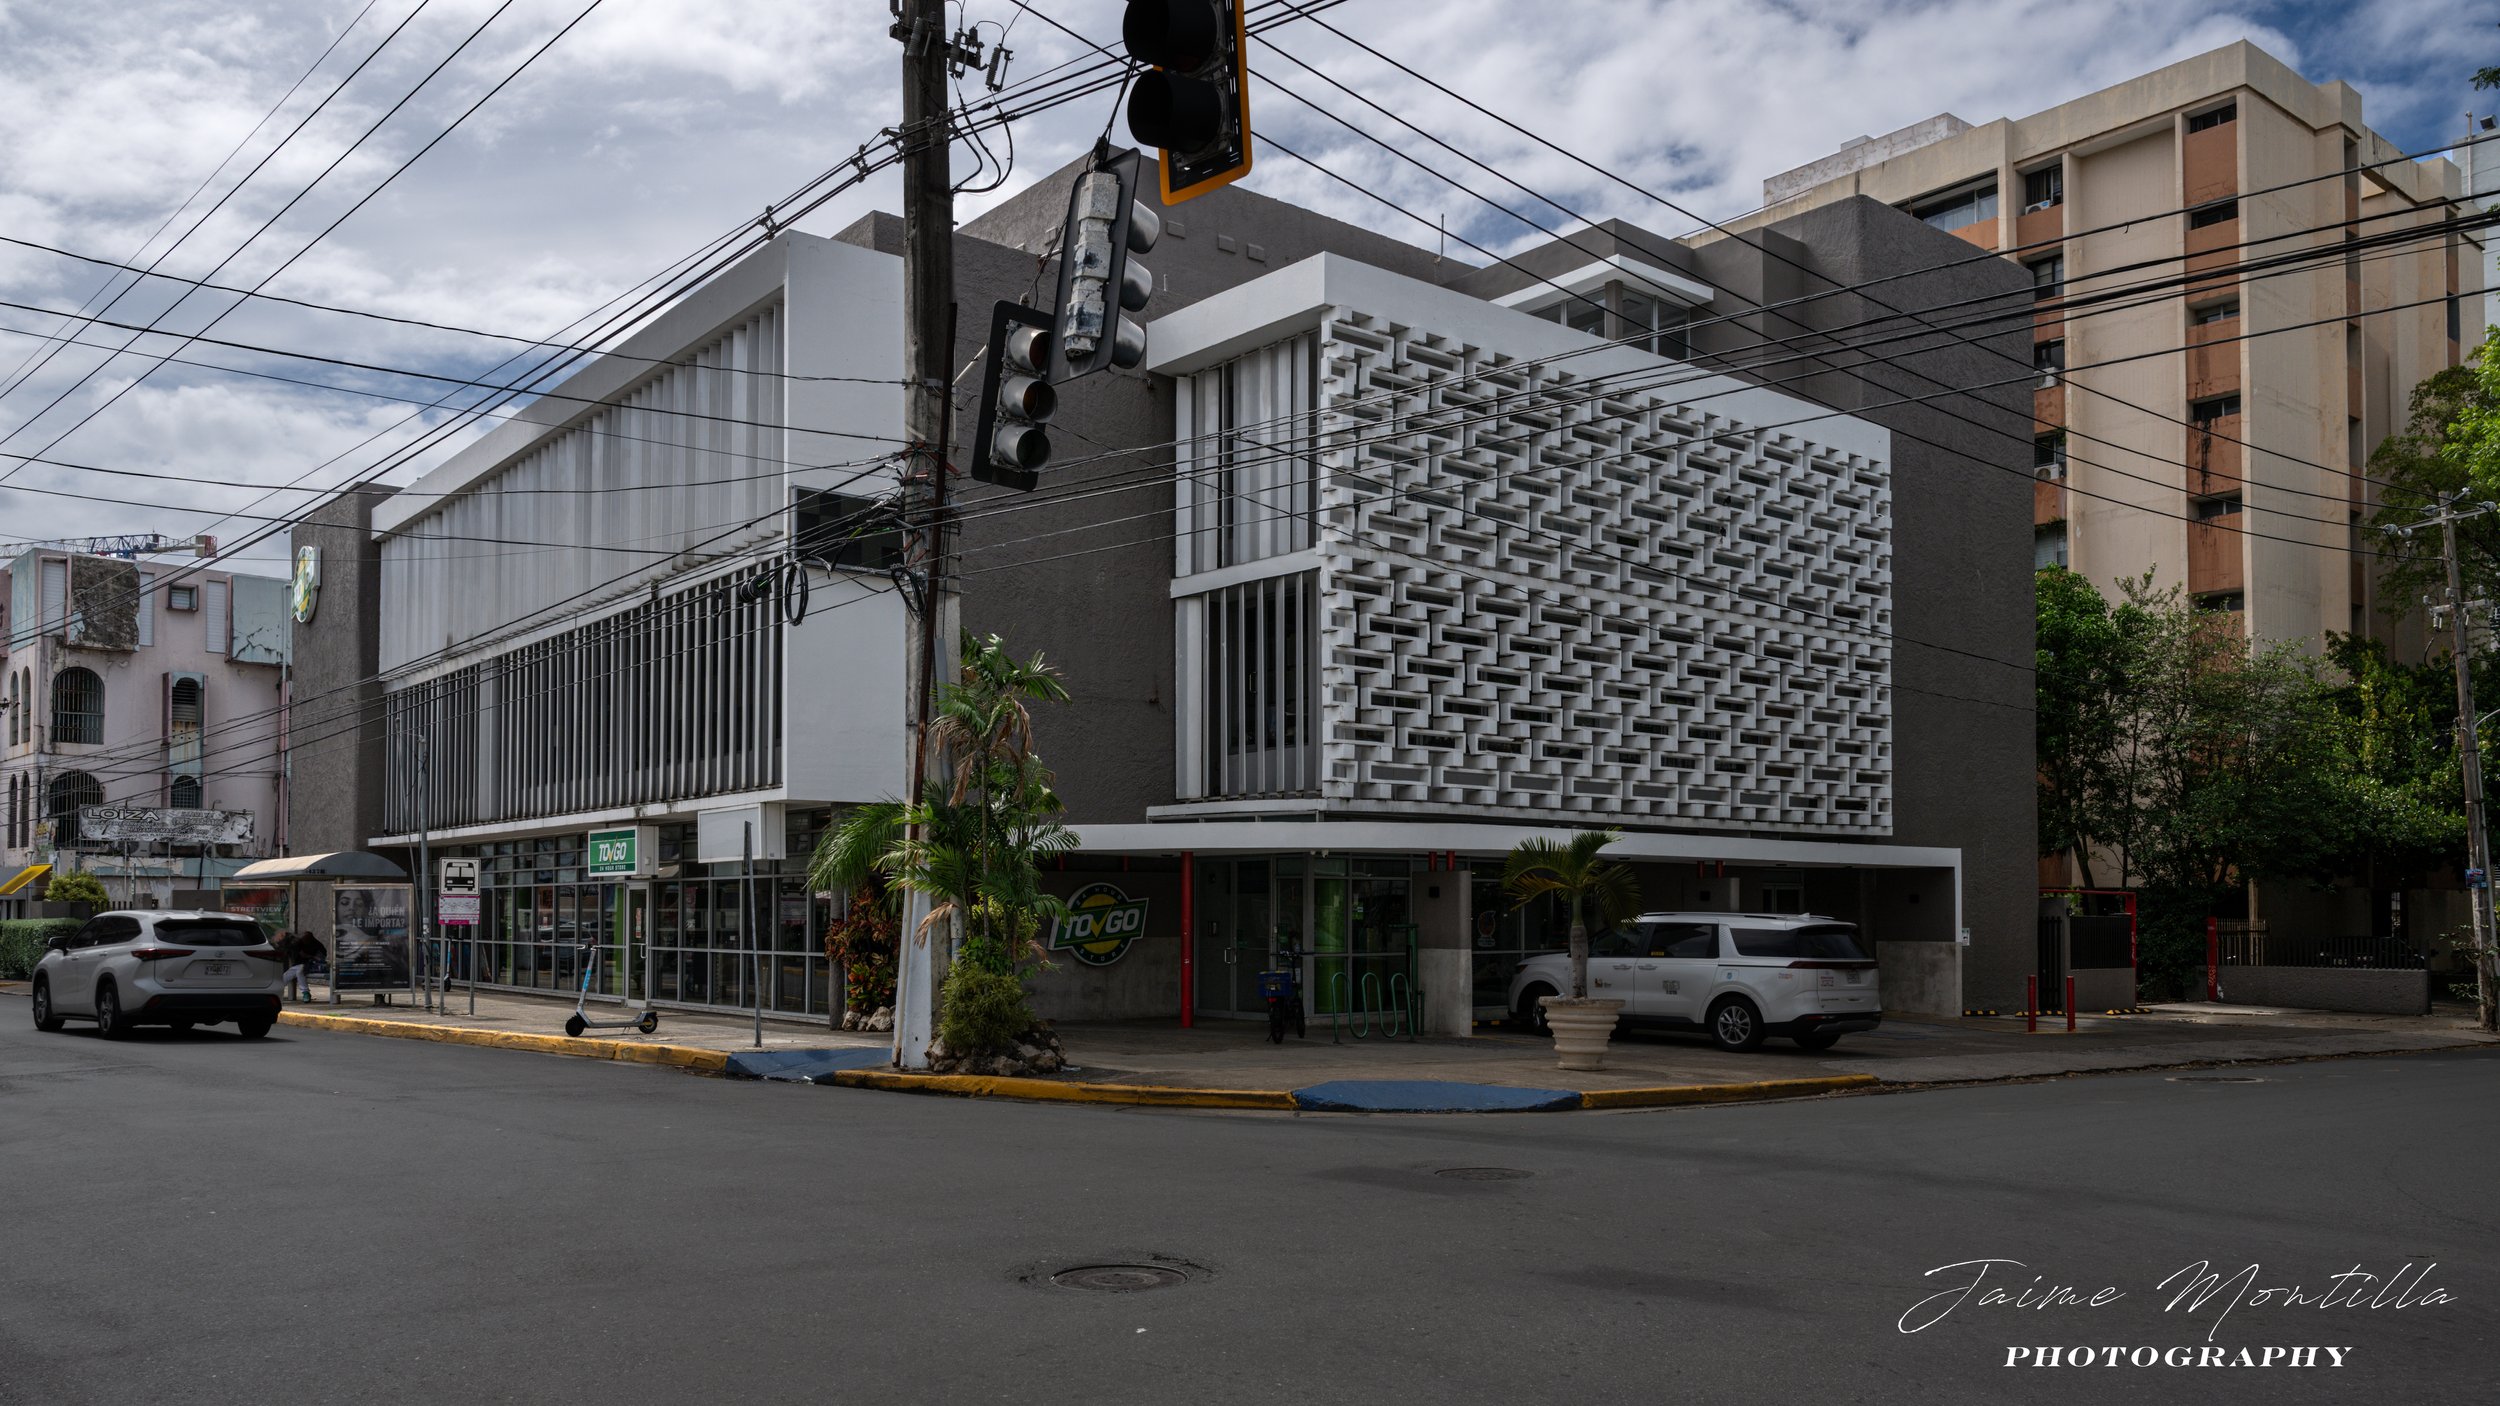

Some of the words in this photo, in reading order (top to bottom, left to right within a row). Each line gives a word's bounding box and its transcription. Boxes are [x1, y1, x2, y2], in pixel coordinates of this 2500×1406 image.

[86, 807, 160, 821] LOIZA
[599, 843, 610, 862] TO
[613, 842, 627, 861] GO
[1094, 887, 1123, 900] HOUR
[352, 918, 362, 928] LE
[364, 918, 405, 928] IMPORTA?
[1105, 908, 1140, 934] GO
